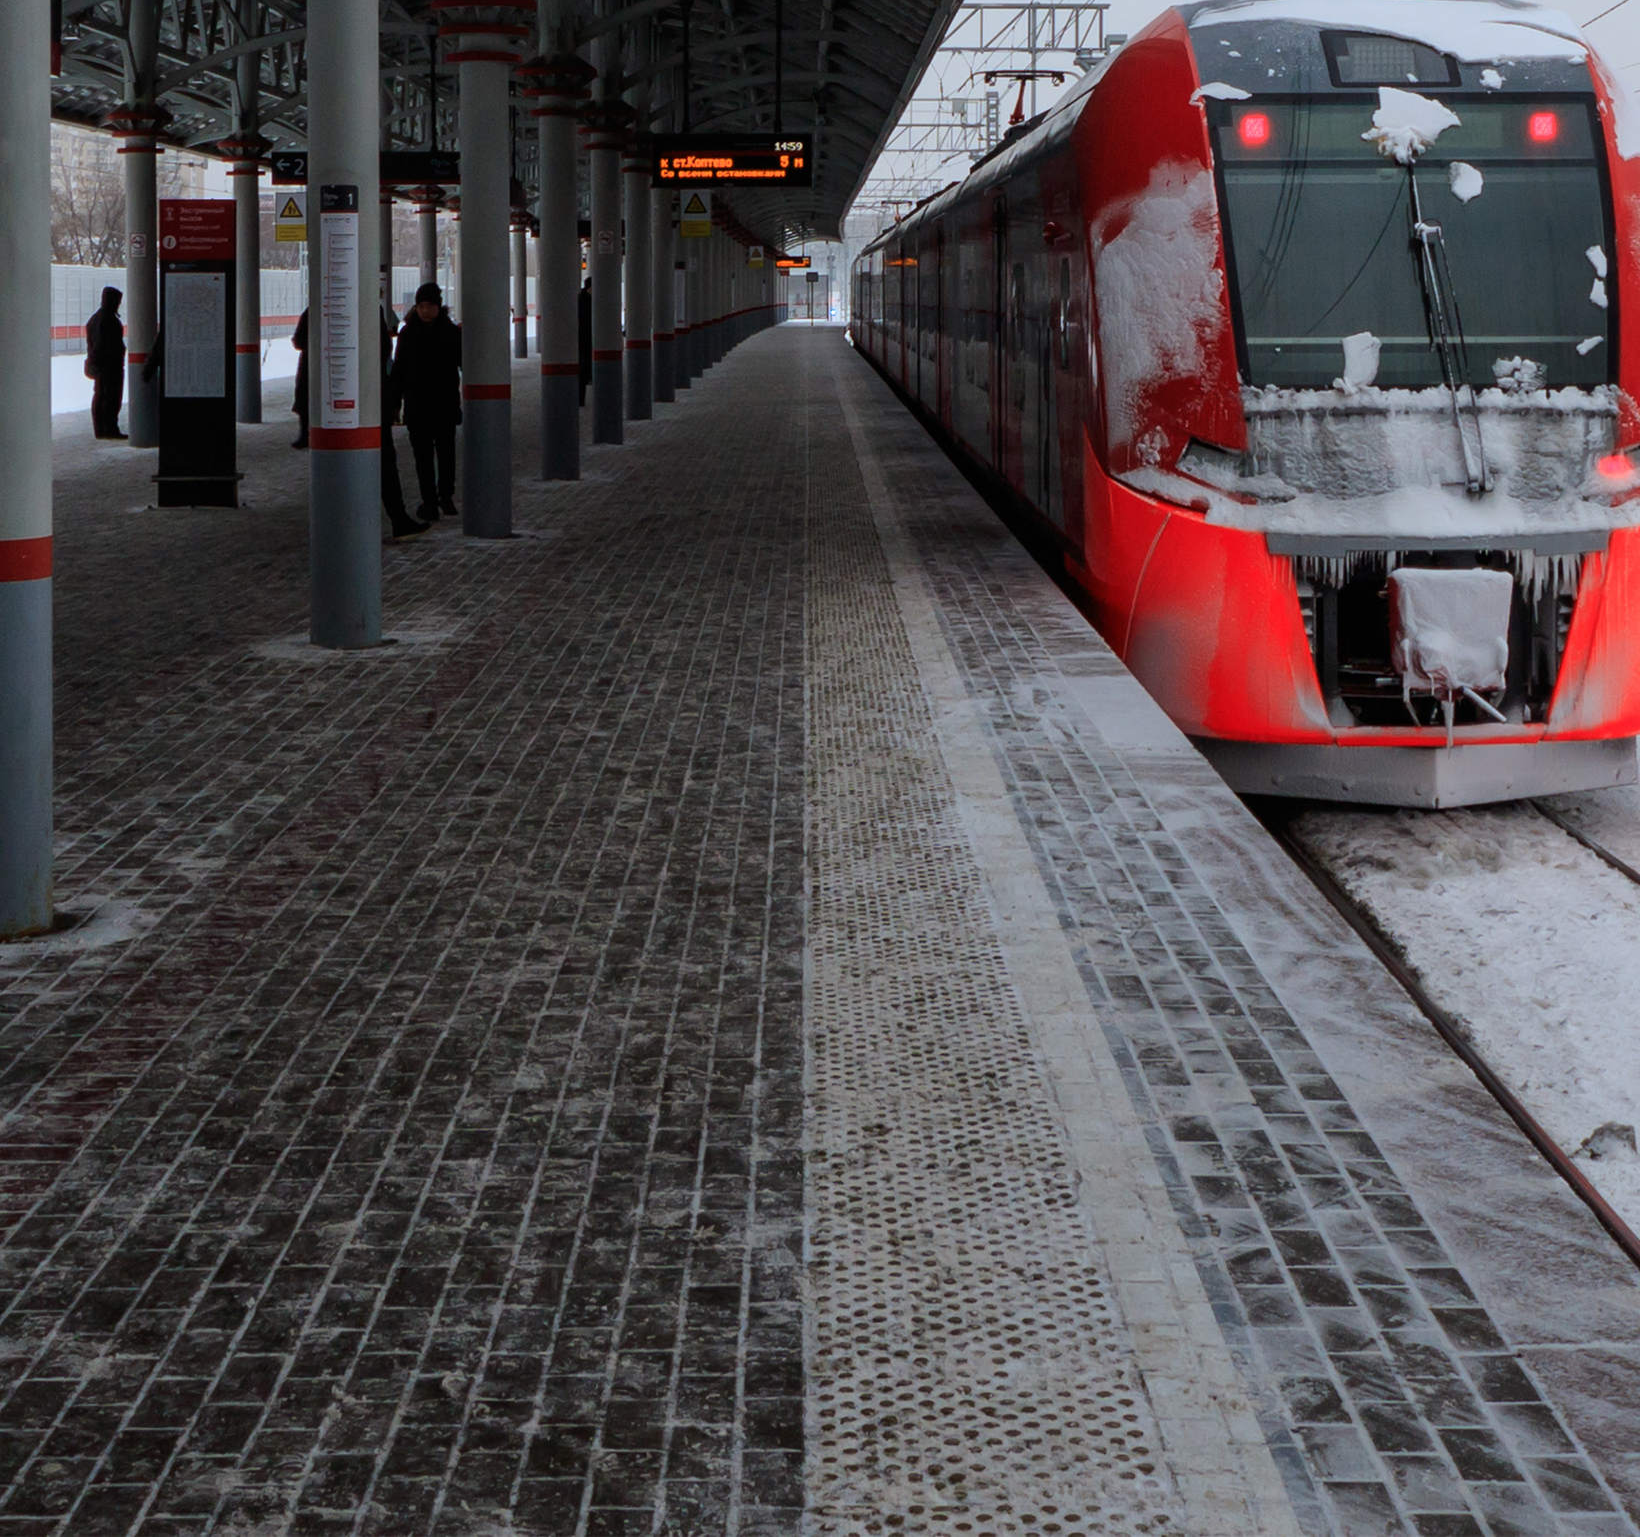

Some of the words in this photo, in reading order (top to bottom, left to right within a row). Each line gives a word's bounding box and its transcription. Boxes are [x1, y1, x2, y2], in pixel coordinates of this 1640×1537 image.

[774, 141, 803, 151] 14:59
[293, 158, 305, 176] 2
[780, 155, 789, 167] 5
[716, 170, 786, 178] остановками
[348, 194, 354, 206] 1
